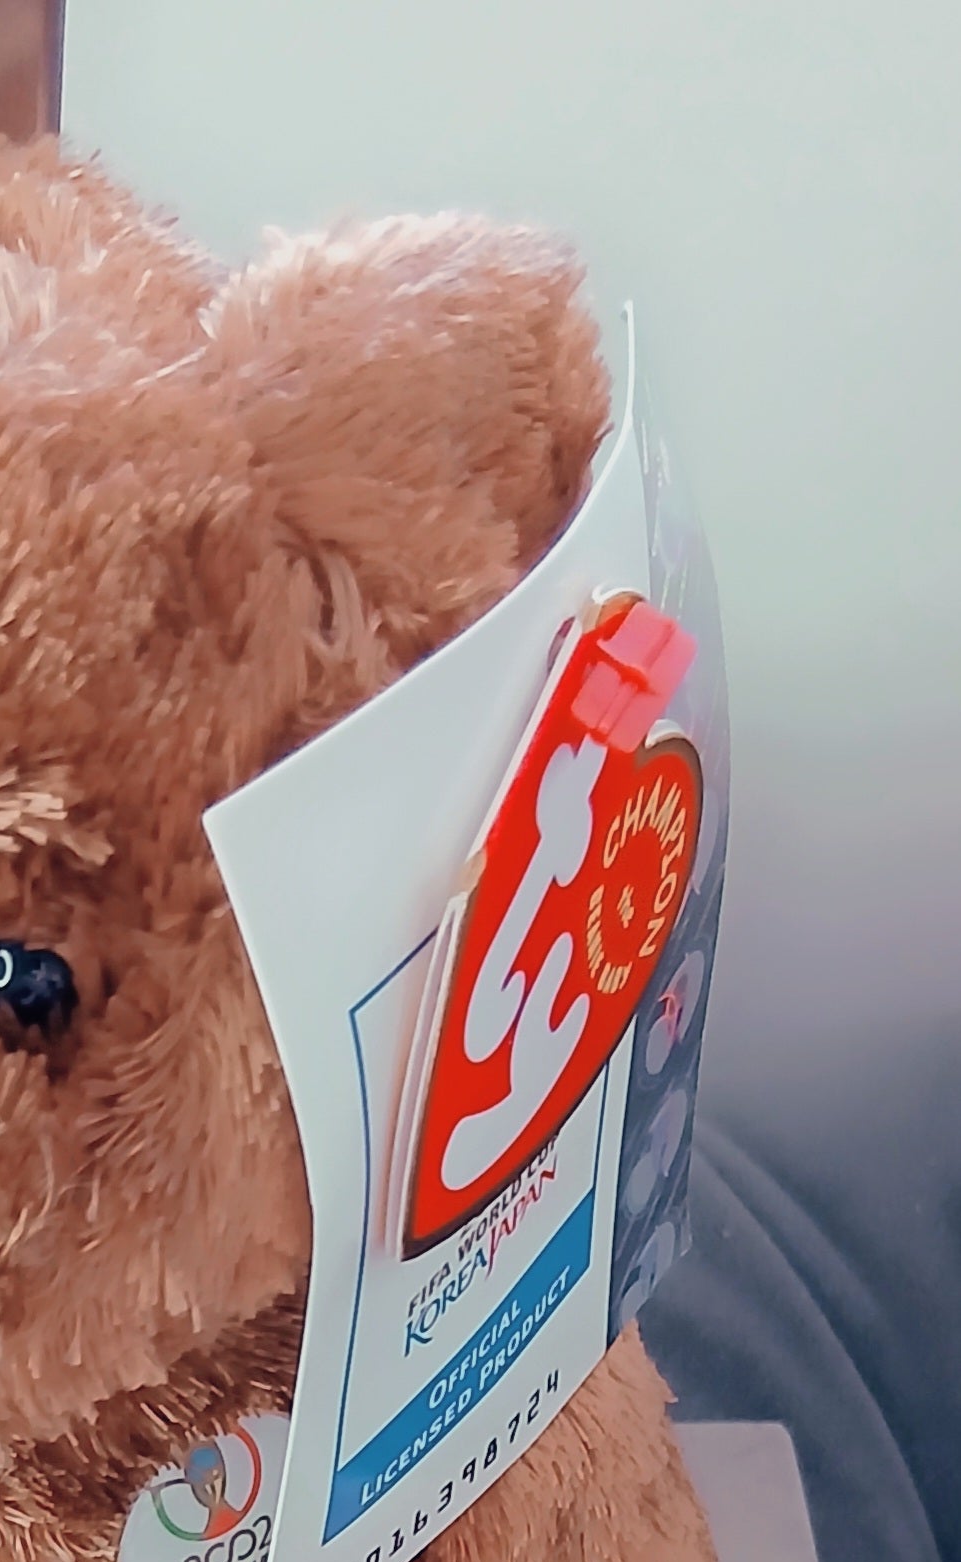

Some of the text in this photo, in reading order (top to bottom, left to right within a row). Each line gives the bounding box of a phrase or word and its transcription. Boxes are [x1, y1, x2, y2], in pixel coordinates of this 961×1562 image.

[603, 774, 687, 958] CHAMPION
[403, 1153, 558, 1358] KOREA JAPAN
[407, 1261, 452, 1318] FIFA
[457, 1174, 523, 1262] WORLD
[359, 1264, 571, 1507] LICENSED PRODUCT
[428, 1299, 522, 1409] OFFICIAL
